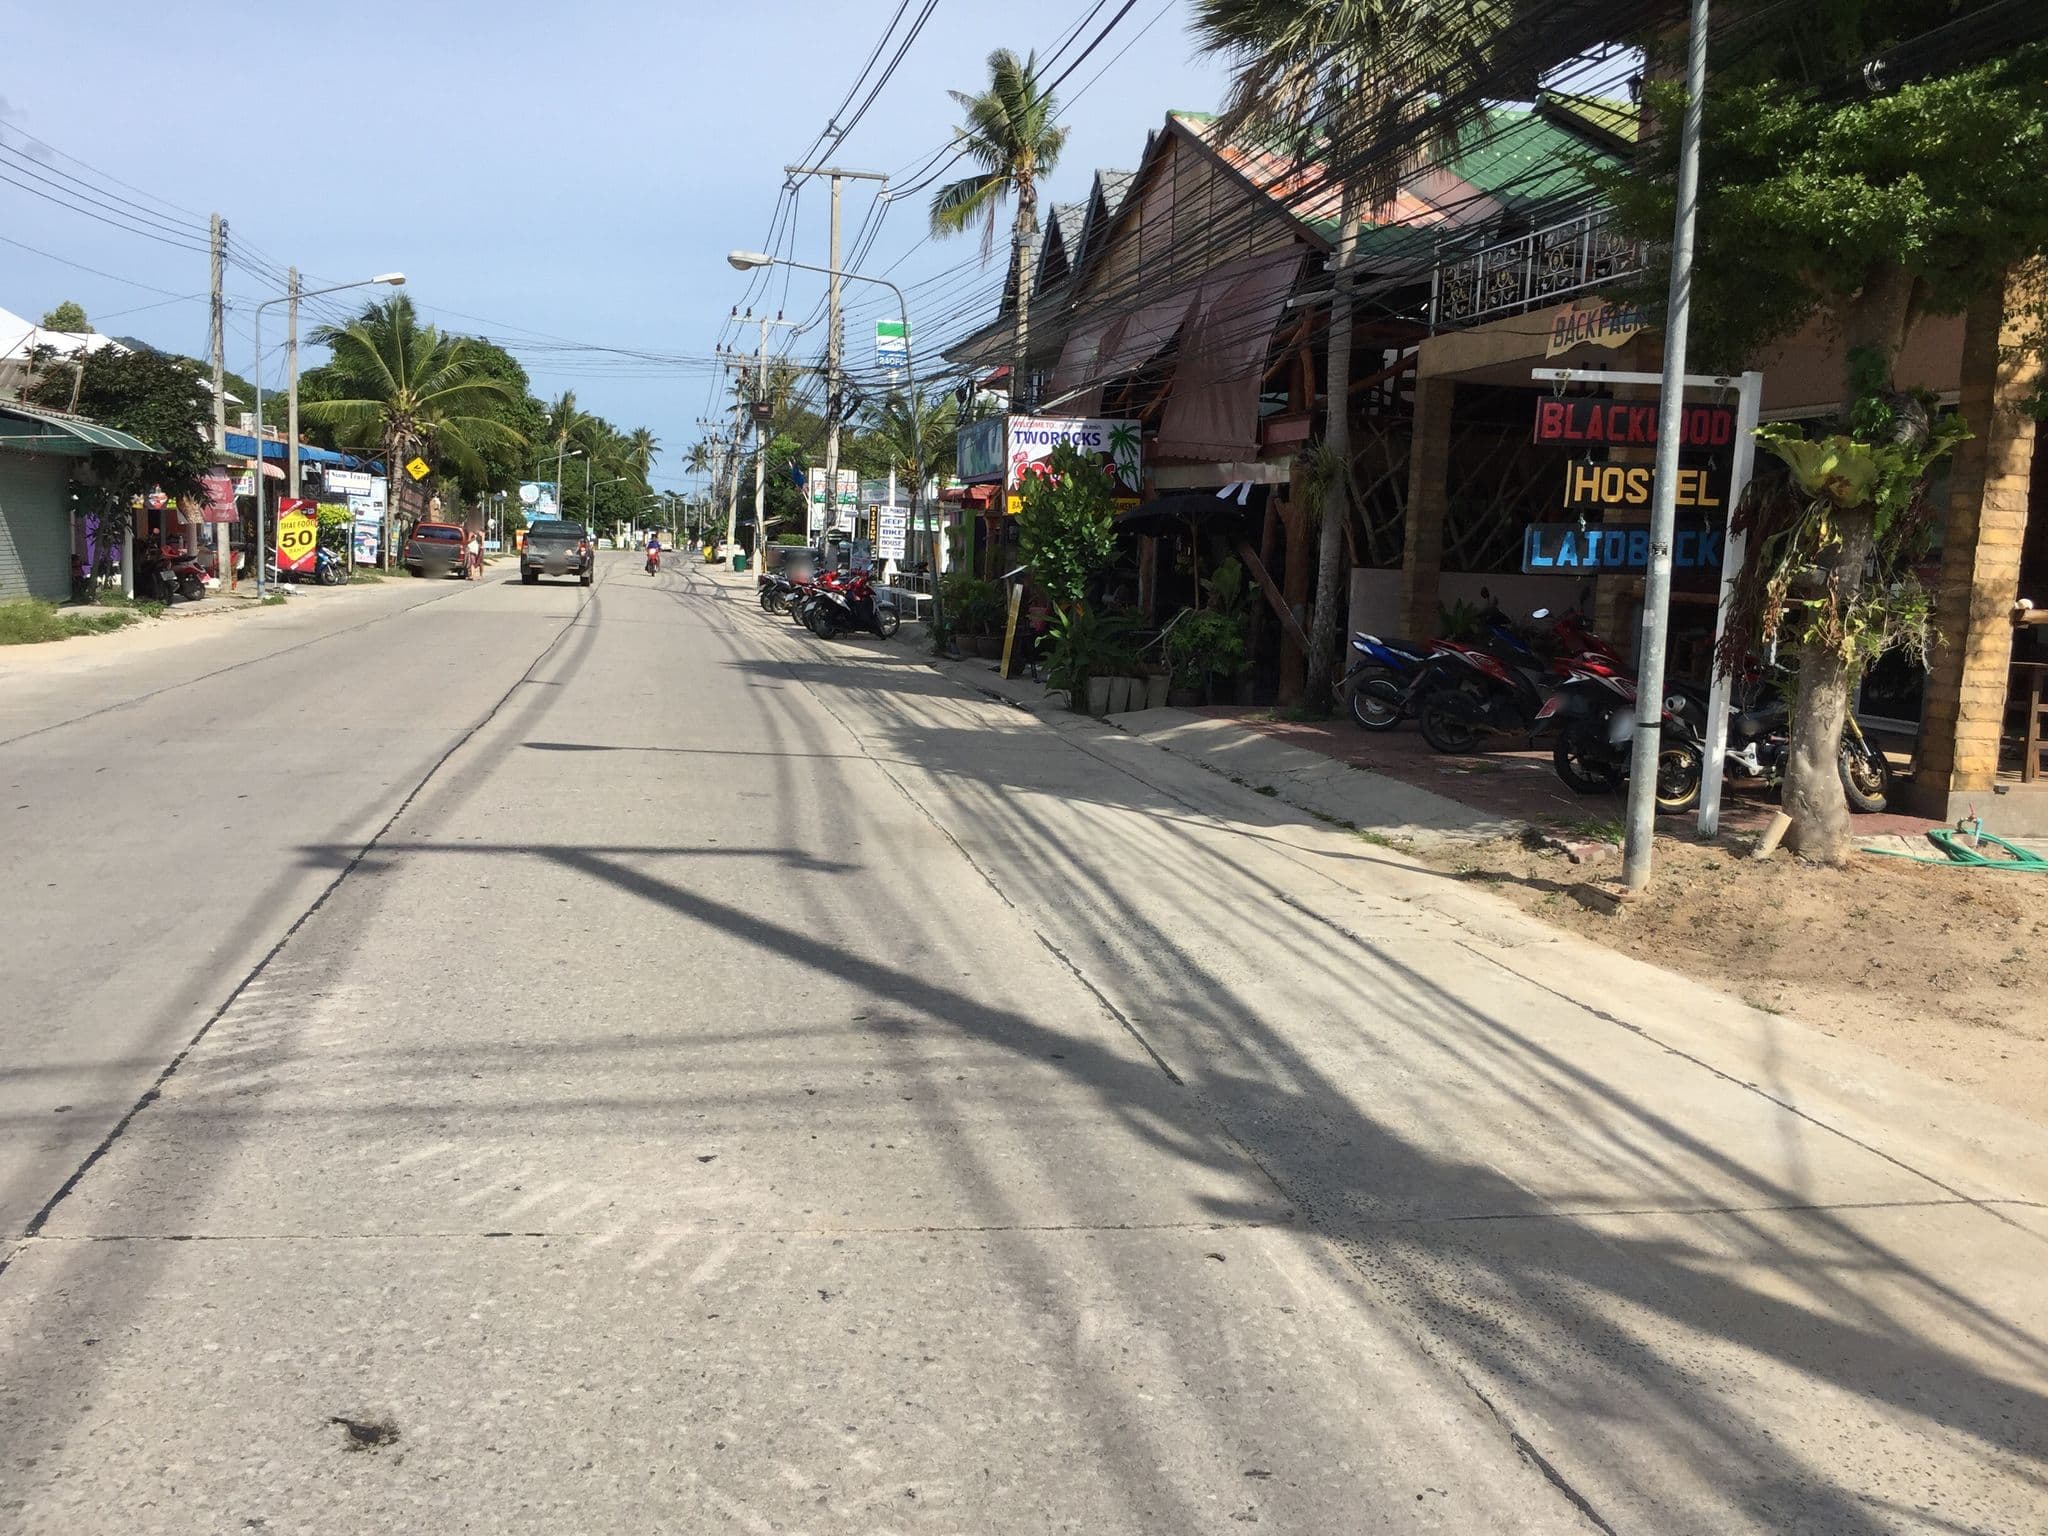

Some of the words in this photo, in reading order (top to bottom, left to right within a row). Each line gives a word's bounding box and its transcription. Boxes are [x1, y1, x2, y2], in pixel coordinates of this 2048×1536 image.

[1014, 430, 1101, 447] TWOROCKS
[1573, 465, 1720, 506] HOSEL
[281, 522, 295, 530] THAI
[297, 520, 314, 528] FOOD
[882, 528, 904, 536] BIKE
[282, 530, 313, 548] 50
[881, 539, 903, 547] HOUSE
[1531, 530, 1720, 567] LAIDBCK
